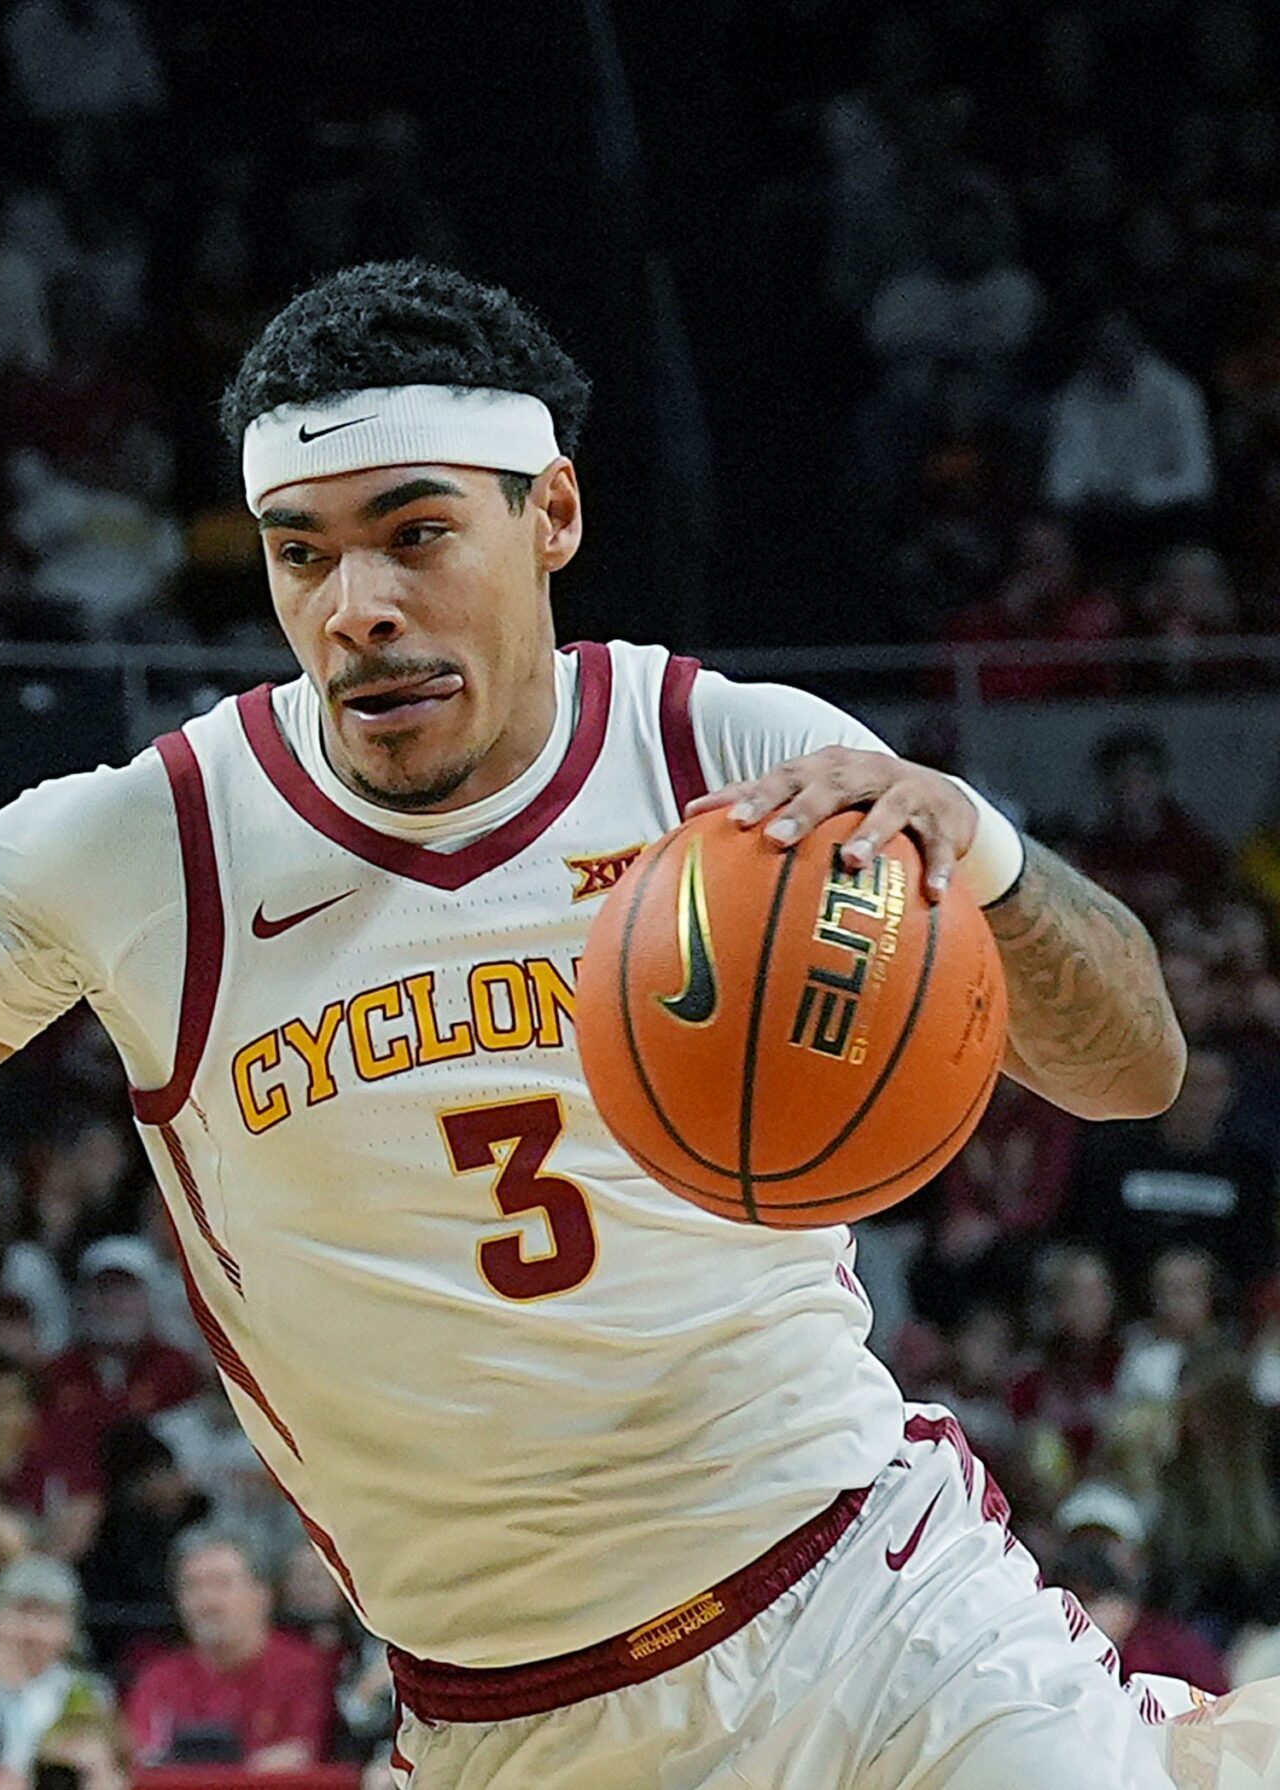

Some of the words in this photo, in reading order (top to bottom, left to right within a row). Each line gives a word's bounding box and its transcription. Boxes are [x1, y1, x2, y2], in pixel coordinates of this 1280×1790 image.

[788, 843, 888, 1061] ELITE
[435, 1092, 601, 1304] 3
[630, 1629, 682, 1660] HILTON
[685, 1601, 725, 1635] MAGIC
